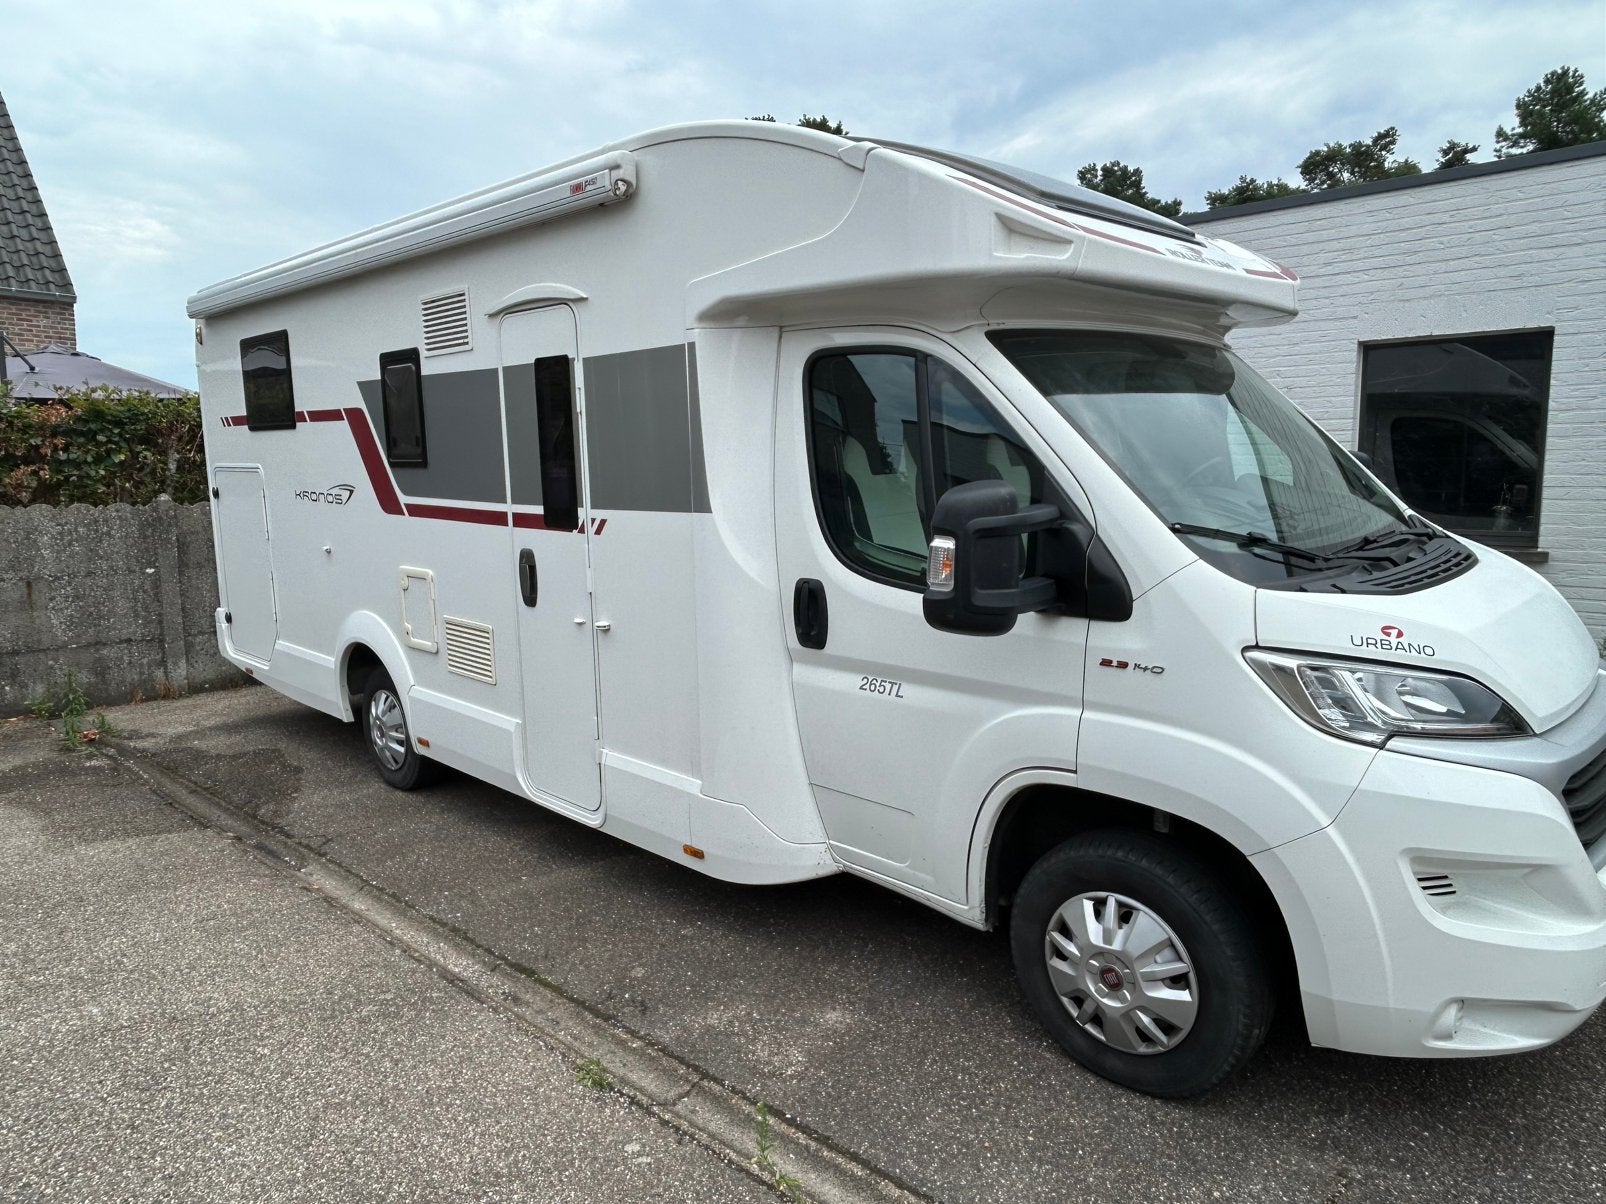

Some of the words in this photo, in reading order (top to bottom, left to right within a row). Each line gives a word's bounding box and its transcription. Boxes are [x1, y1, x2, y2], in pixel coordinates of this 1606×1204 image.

[294, 489, 343, 505] KRONOS
[1350, 634, 1435, 657] URBANO
[858, 675, 904, 699] 265TL
